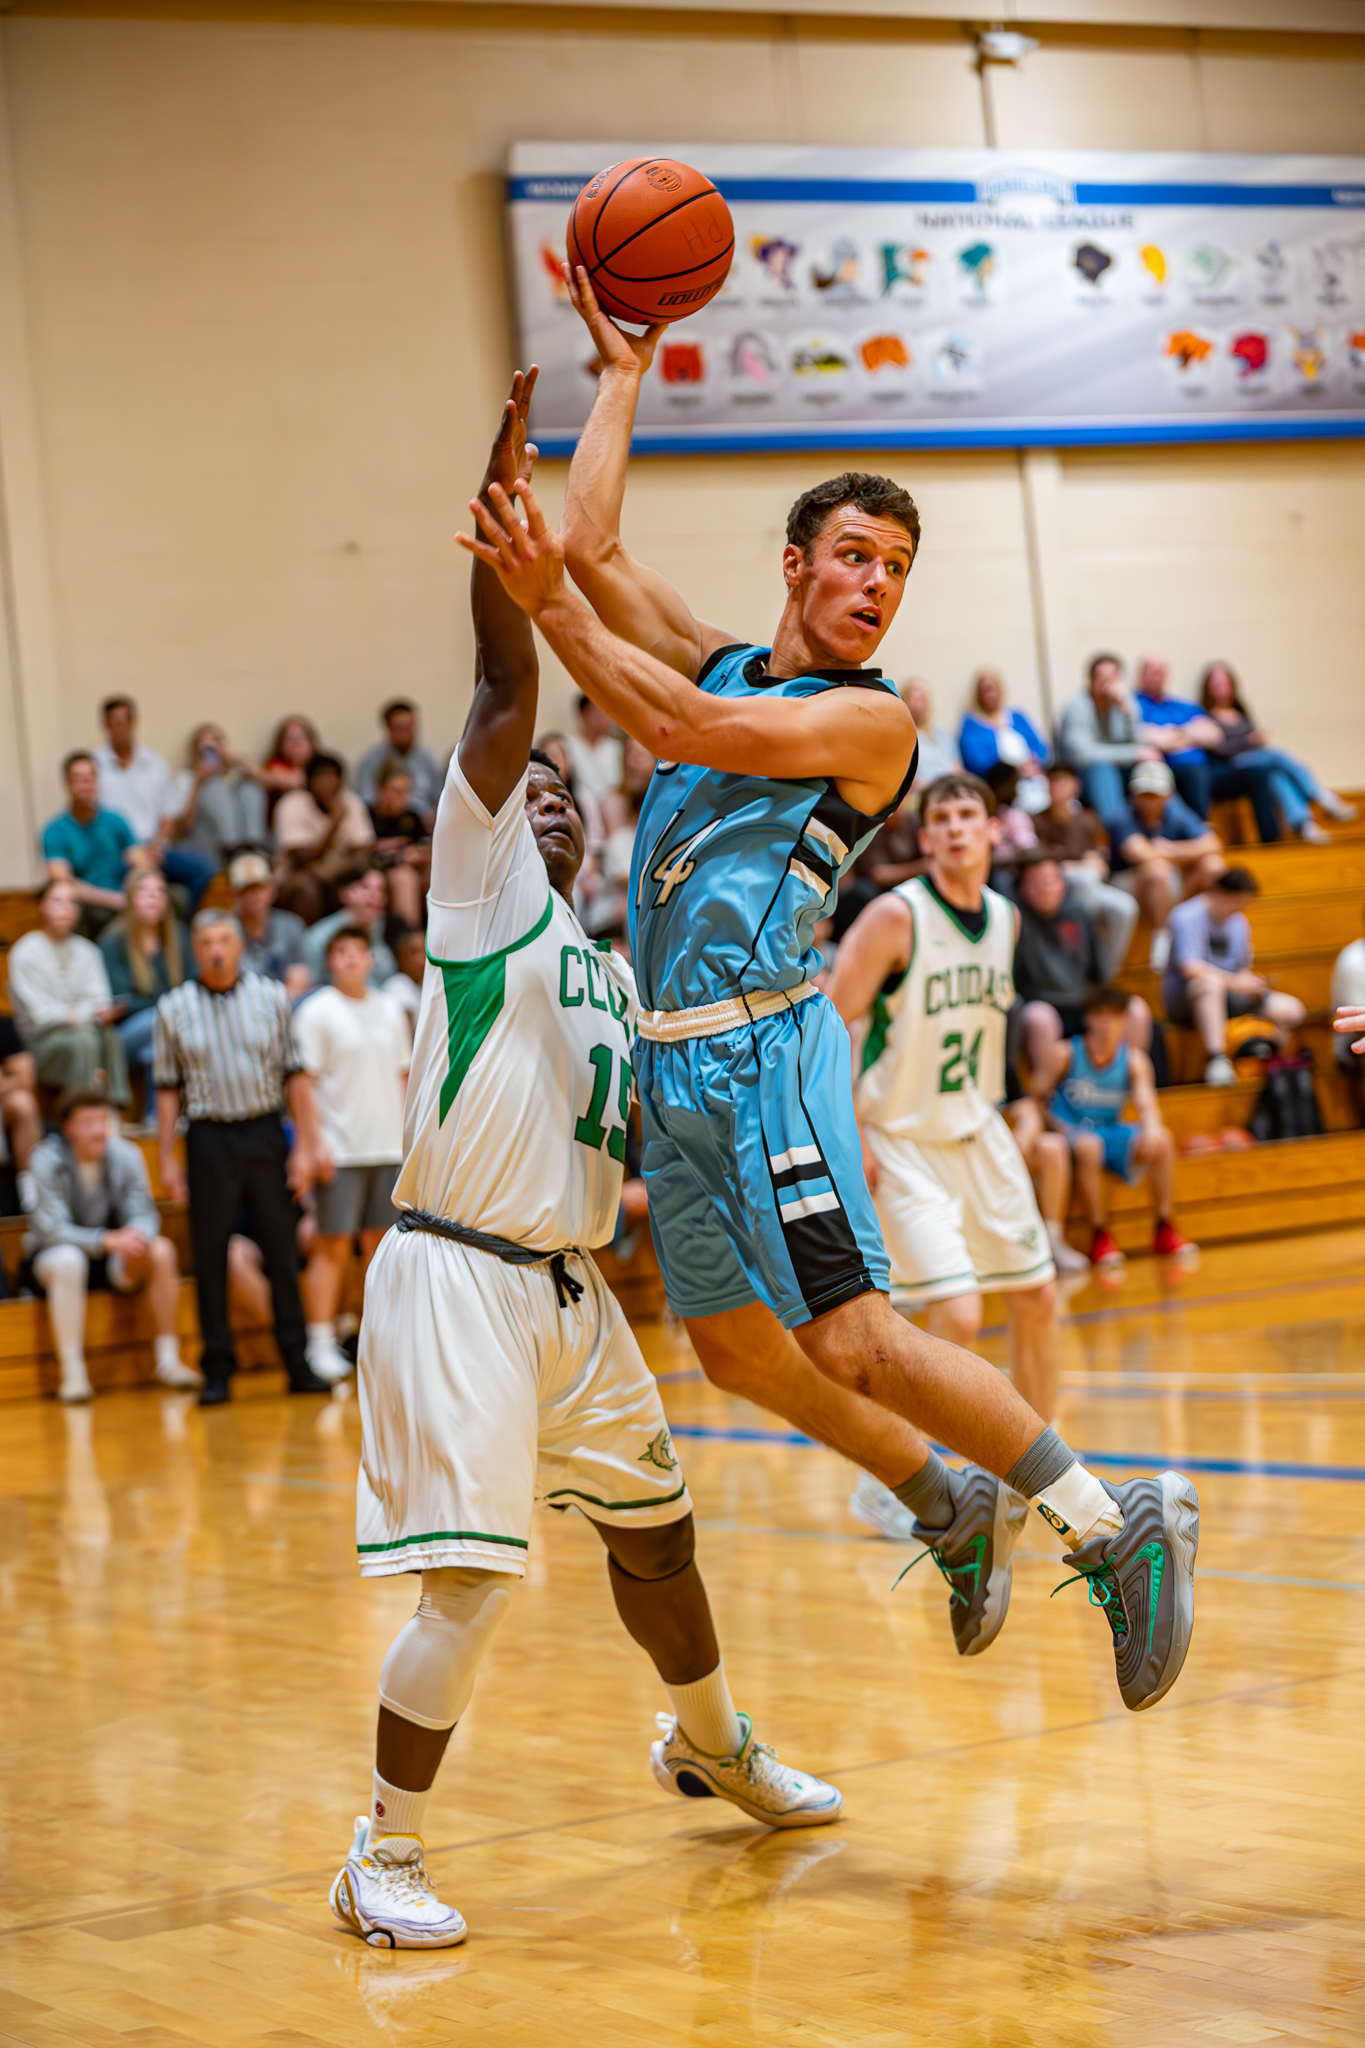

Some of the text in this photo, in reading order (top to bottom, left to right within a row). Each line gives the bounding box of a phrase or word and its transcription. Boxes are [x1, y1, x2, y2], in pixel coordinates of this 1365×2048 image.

[635, 808, 726, 910] 14
[574, 1042, 632, 1163] 15
[939, 1027, 985, 1094] 24
